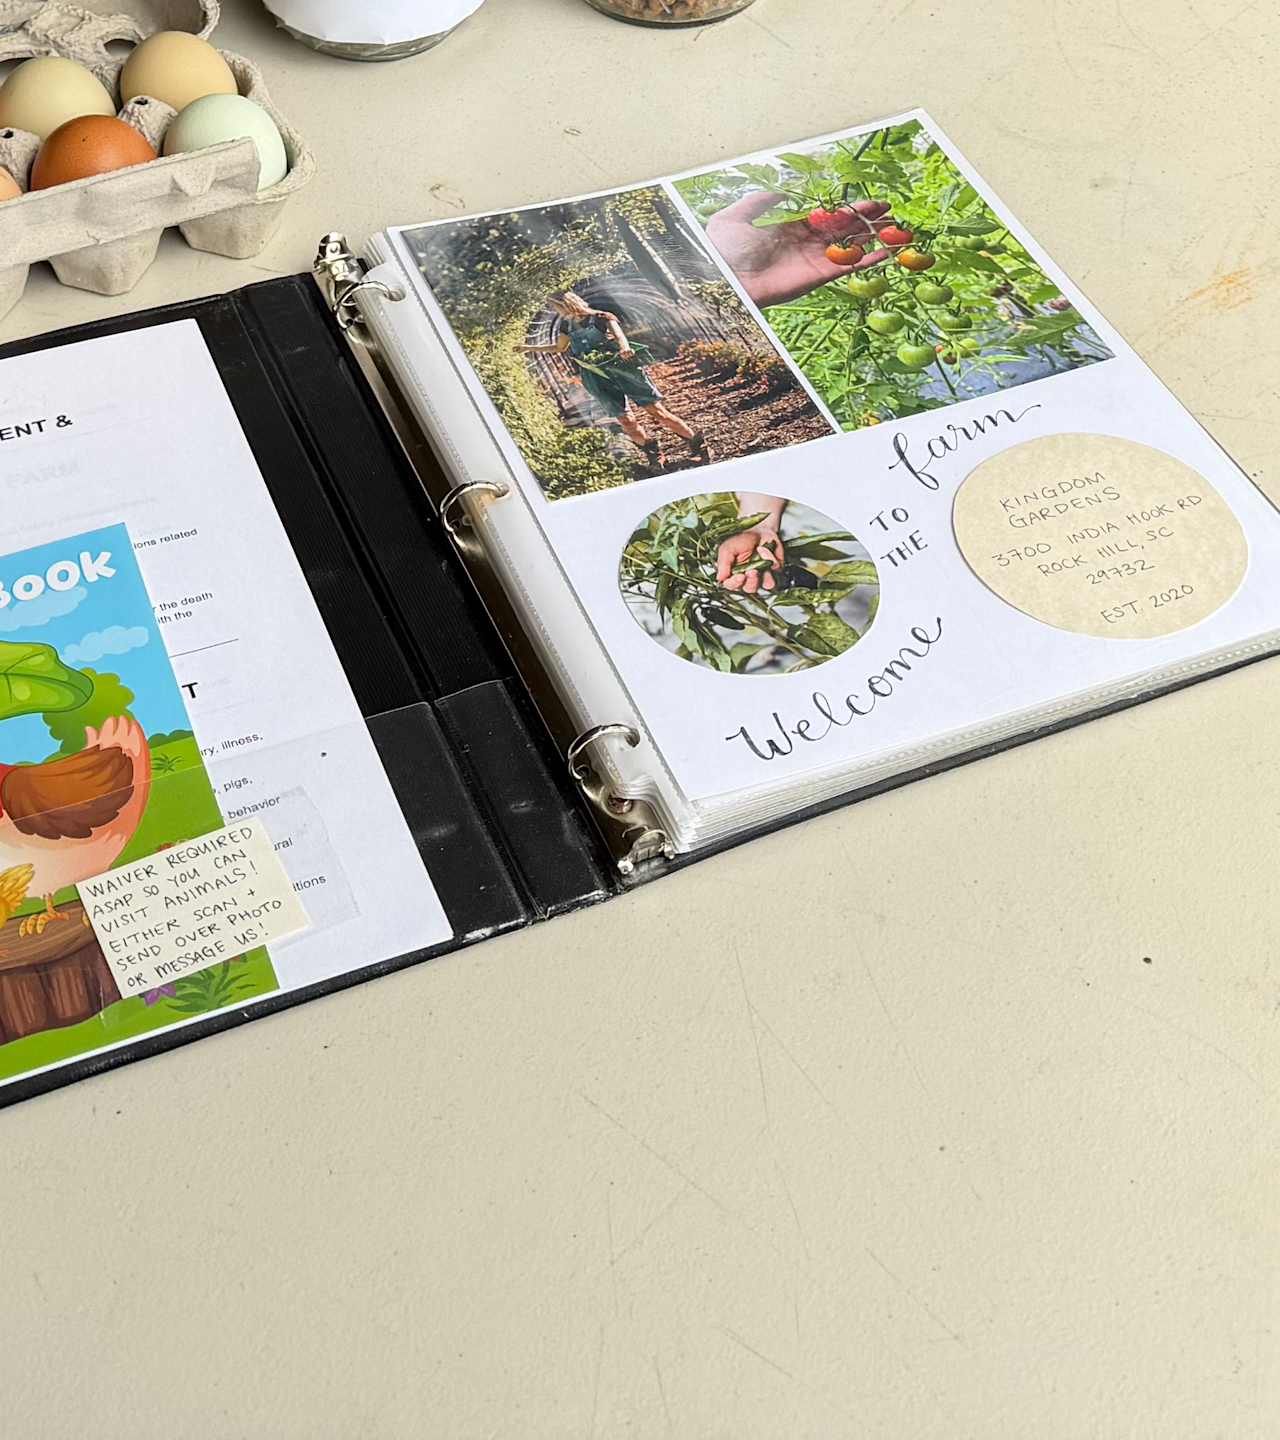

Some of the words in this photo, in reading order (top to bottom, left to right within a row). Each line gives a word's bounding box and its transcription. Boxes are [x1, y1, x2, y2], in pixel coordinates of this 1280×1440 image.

[55, 414, 74, 428] &
[888, 403, 1042, 492] farm
[998, 471, 1107, 514] KINGDOM
[1008, 486, 1122, 529] GARDENS
[160, 527, 199, 544] related
[869, 506, 910, 533] TO
[991, 541, 1052, 568] 3700
[1066, 521, 1121, 546] INDIA
[1125, 503, 1175, 527] HOOK
[1176, 494, 1203, 512] RD
[880, 529, 929, 569] THE
[1036, 553, 1089, 577] ROCK
[1097, 538, 1146, 560] HILL,
[1146, 525, 1175, 543] SC
[1086, 558, 1156, 586] 29732
[159, 601, 178, 613] the
[180, 591, 214, 607] death
[174, 609, 193, 621] the
[1148, 583, 1195, 609] 2020
[181, 681, 199, 699] T
[725, 616, 943, 762] Welcome
[227, 795, 282, 820] behavior
[86, 863, 161, 899] WAIVER
[165, 825, 254, 869] REQUIRED
[92, 892, 134, 920] ASAP
[143, 883, 160, 899] SO
[167, 867, 201, 889] YOU
[213, 848, 248, 871] CAN
[101, 906, 150, 935] VISIT
[109, 918, 182, 954] EITHER
[193, 897, 239, 923] SCAN
[116, 944, 163, 973] SEND
[175, 922, 222, 949] OVER
[226, 899, 283, 927] PHOTO
[127, 974, 149, 989] OR
[155, 940, 227, 980] MESSAGE
